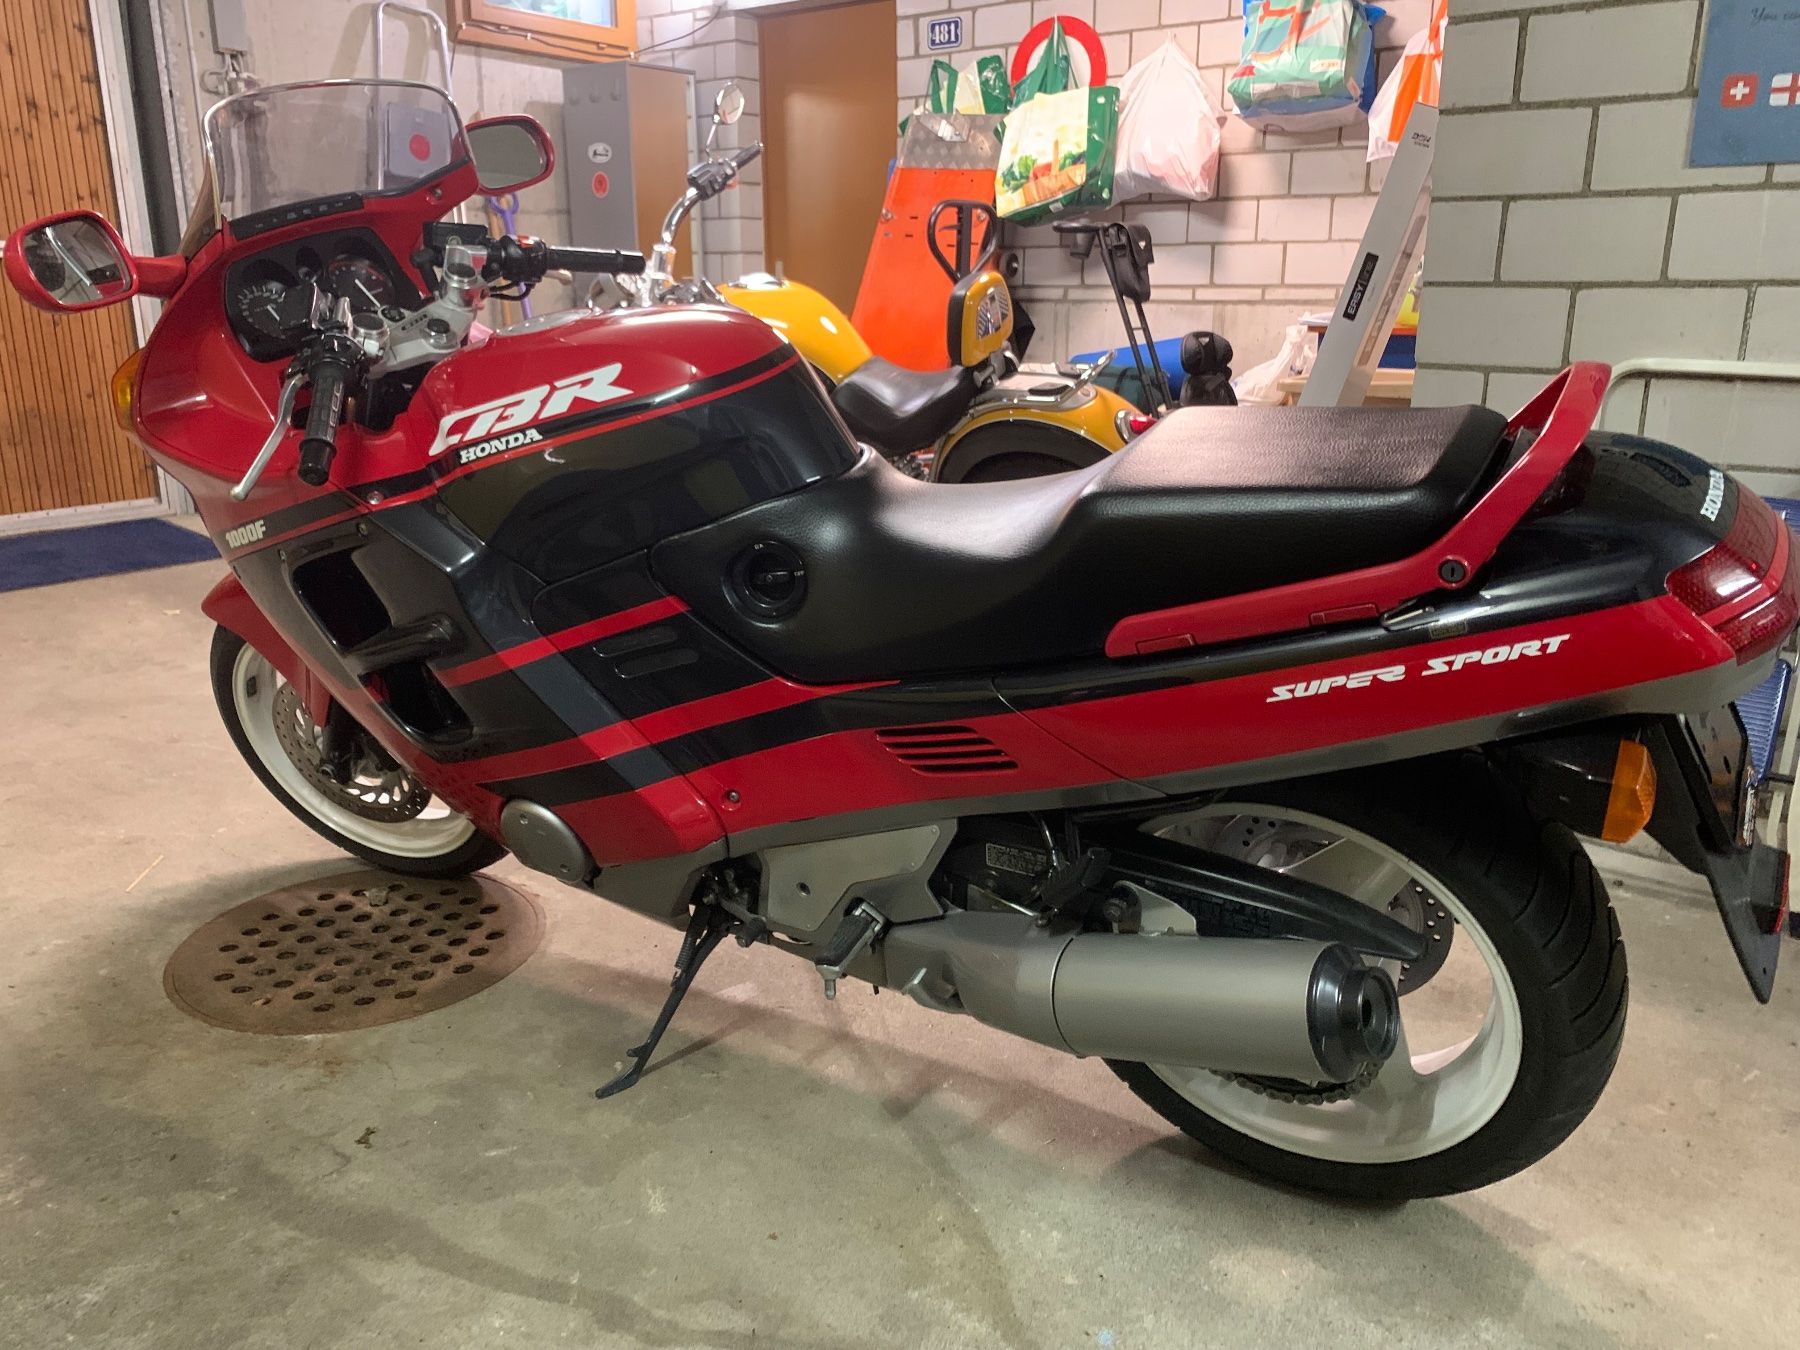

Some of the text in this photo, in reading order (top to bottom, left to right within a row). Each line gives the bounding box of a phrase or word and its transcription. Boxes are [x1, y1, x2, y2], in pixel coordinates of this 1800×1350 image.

[932, 22, 956, 44] 481
[428, 362, 634, 456] CBR
[459, 428, 543, 464] HONDA
[1700, 468, 1725, 522] HONDA
[225, 519, 266, 549] 1000F
[1266, 634, 1571, 703] SUPER SPORT
